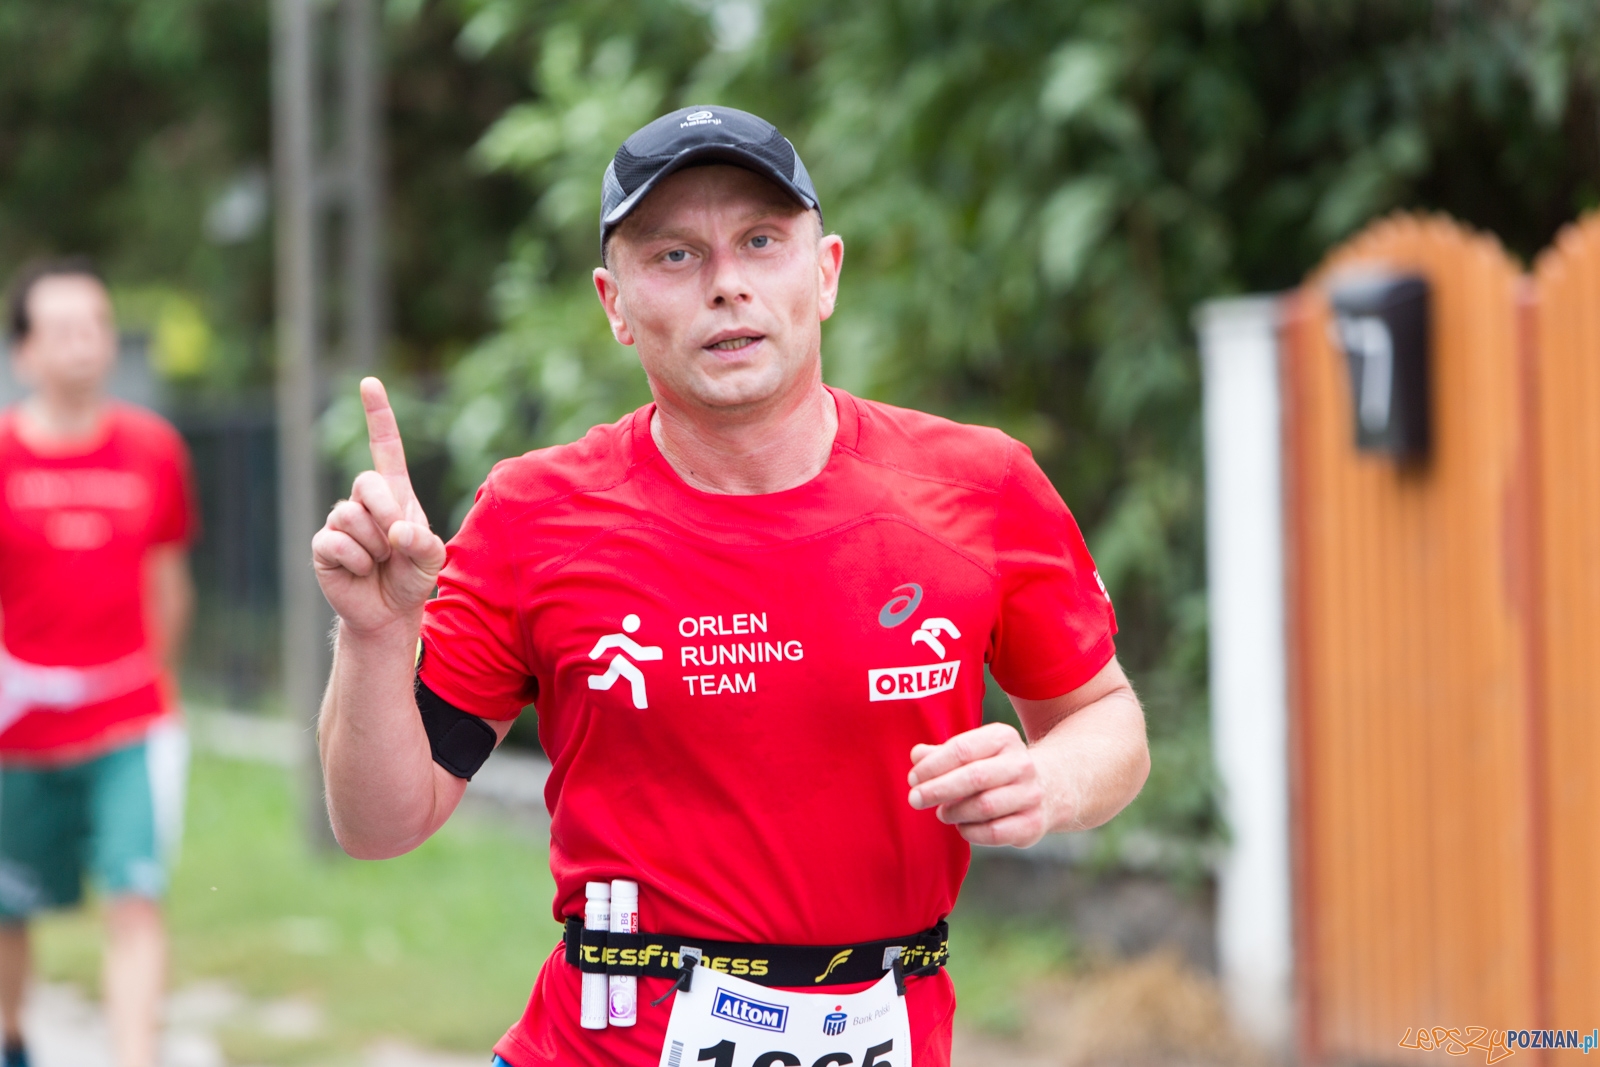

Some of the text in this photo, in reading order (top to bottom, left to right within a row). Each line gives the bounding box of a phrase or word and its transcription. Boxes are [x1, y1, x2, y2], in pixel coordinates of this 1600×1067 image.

[678, 612, 768, 638] ORLEN
[680, 640, 804, 667] RUNNING
[682, 672, 757, 696] TEAM
[875, 666, 954, 695] ORLEN
